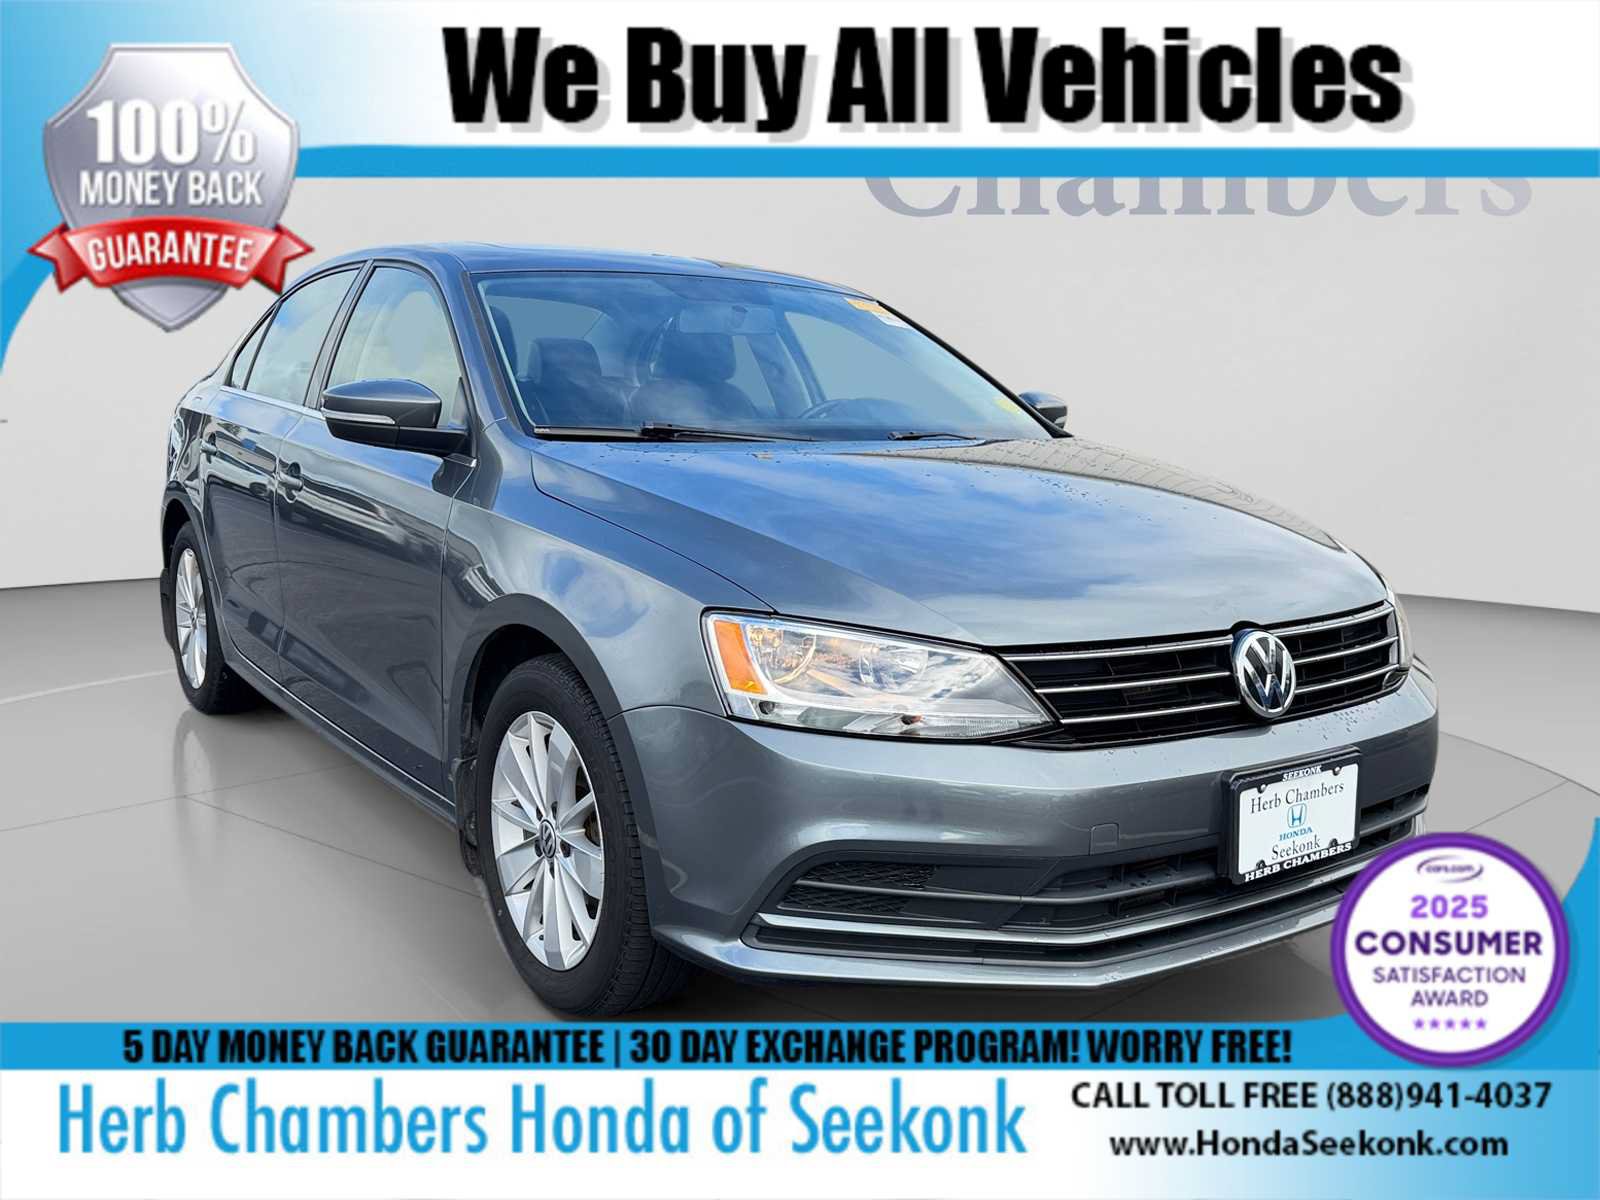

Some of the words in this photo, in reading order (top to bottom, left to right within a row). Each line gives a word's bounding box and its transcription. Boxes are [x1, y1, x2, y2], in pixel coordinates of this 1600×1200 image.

[1282, 765, 1322, 782] SEEKONK
[1250, 795, 1282, 814] Herb
[1285, 782, 1344, 805] Chambers
[1279, 826, 1313, 841] HONDA
[1271, 834, 1321, 861] Seekonk
[1244, 863, 1281, 882] HERB
[1283, 842, 1352, 870] CHAMBERS
